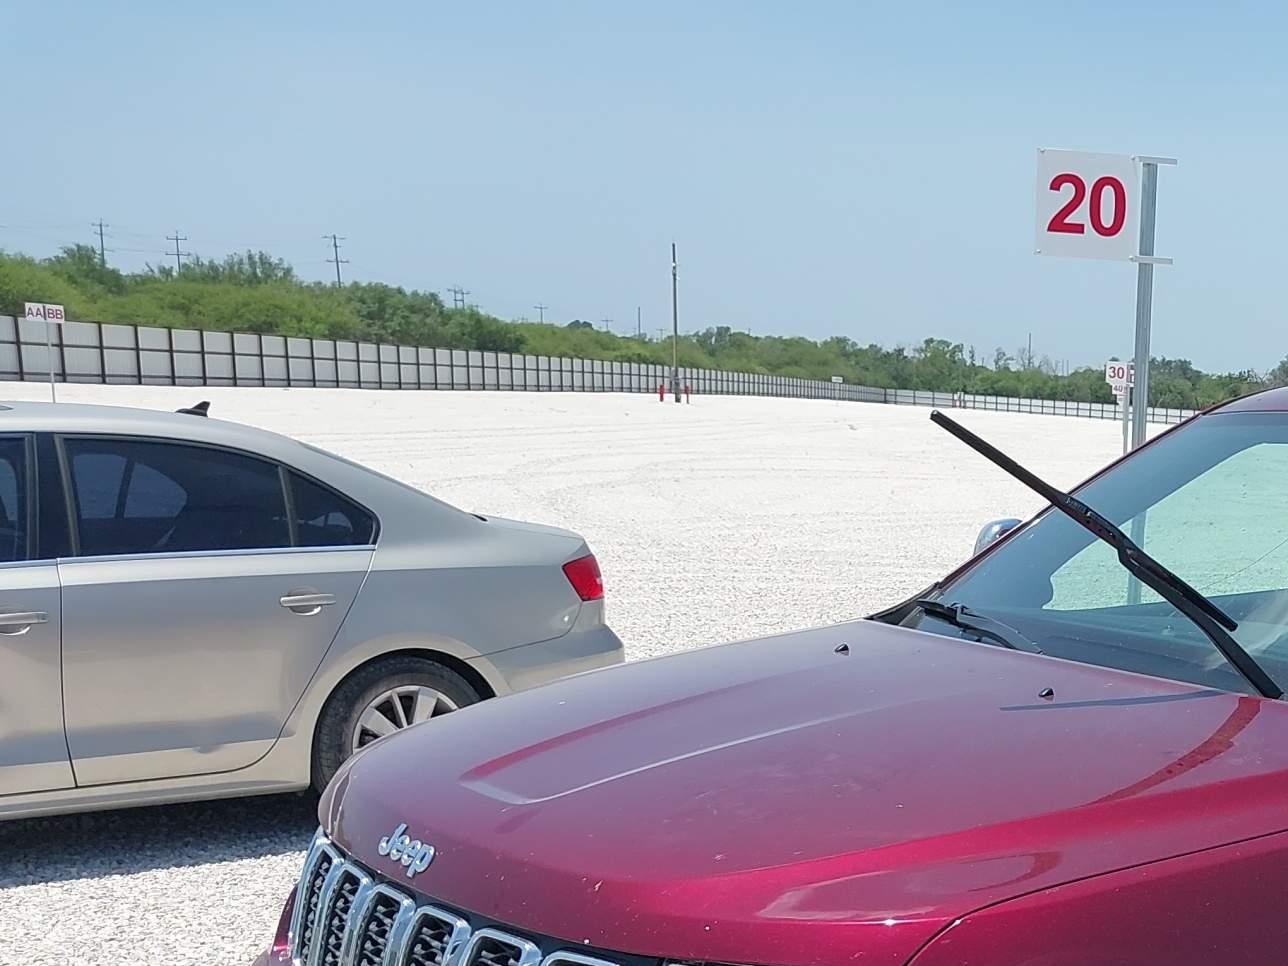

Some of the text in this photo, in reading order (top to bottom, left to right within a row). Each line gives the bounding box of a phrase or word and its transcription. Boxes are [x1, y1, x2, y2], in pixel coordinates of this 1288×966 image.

[1047, 173, 1126, 237] 20
[27, 307, 64, 320] AA BB
[1109, 366, 1125, 379] 30
[378, 823, 435, 878] Jeep
